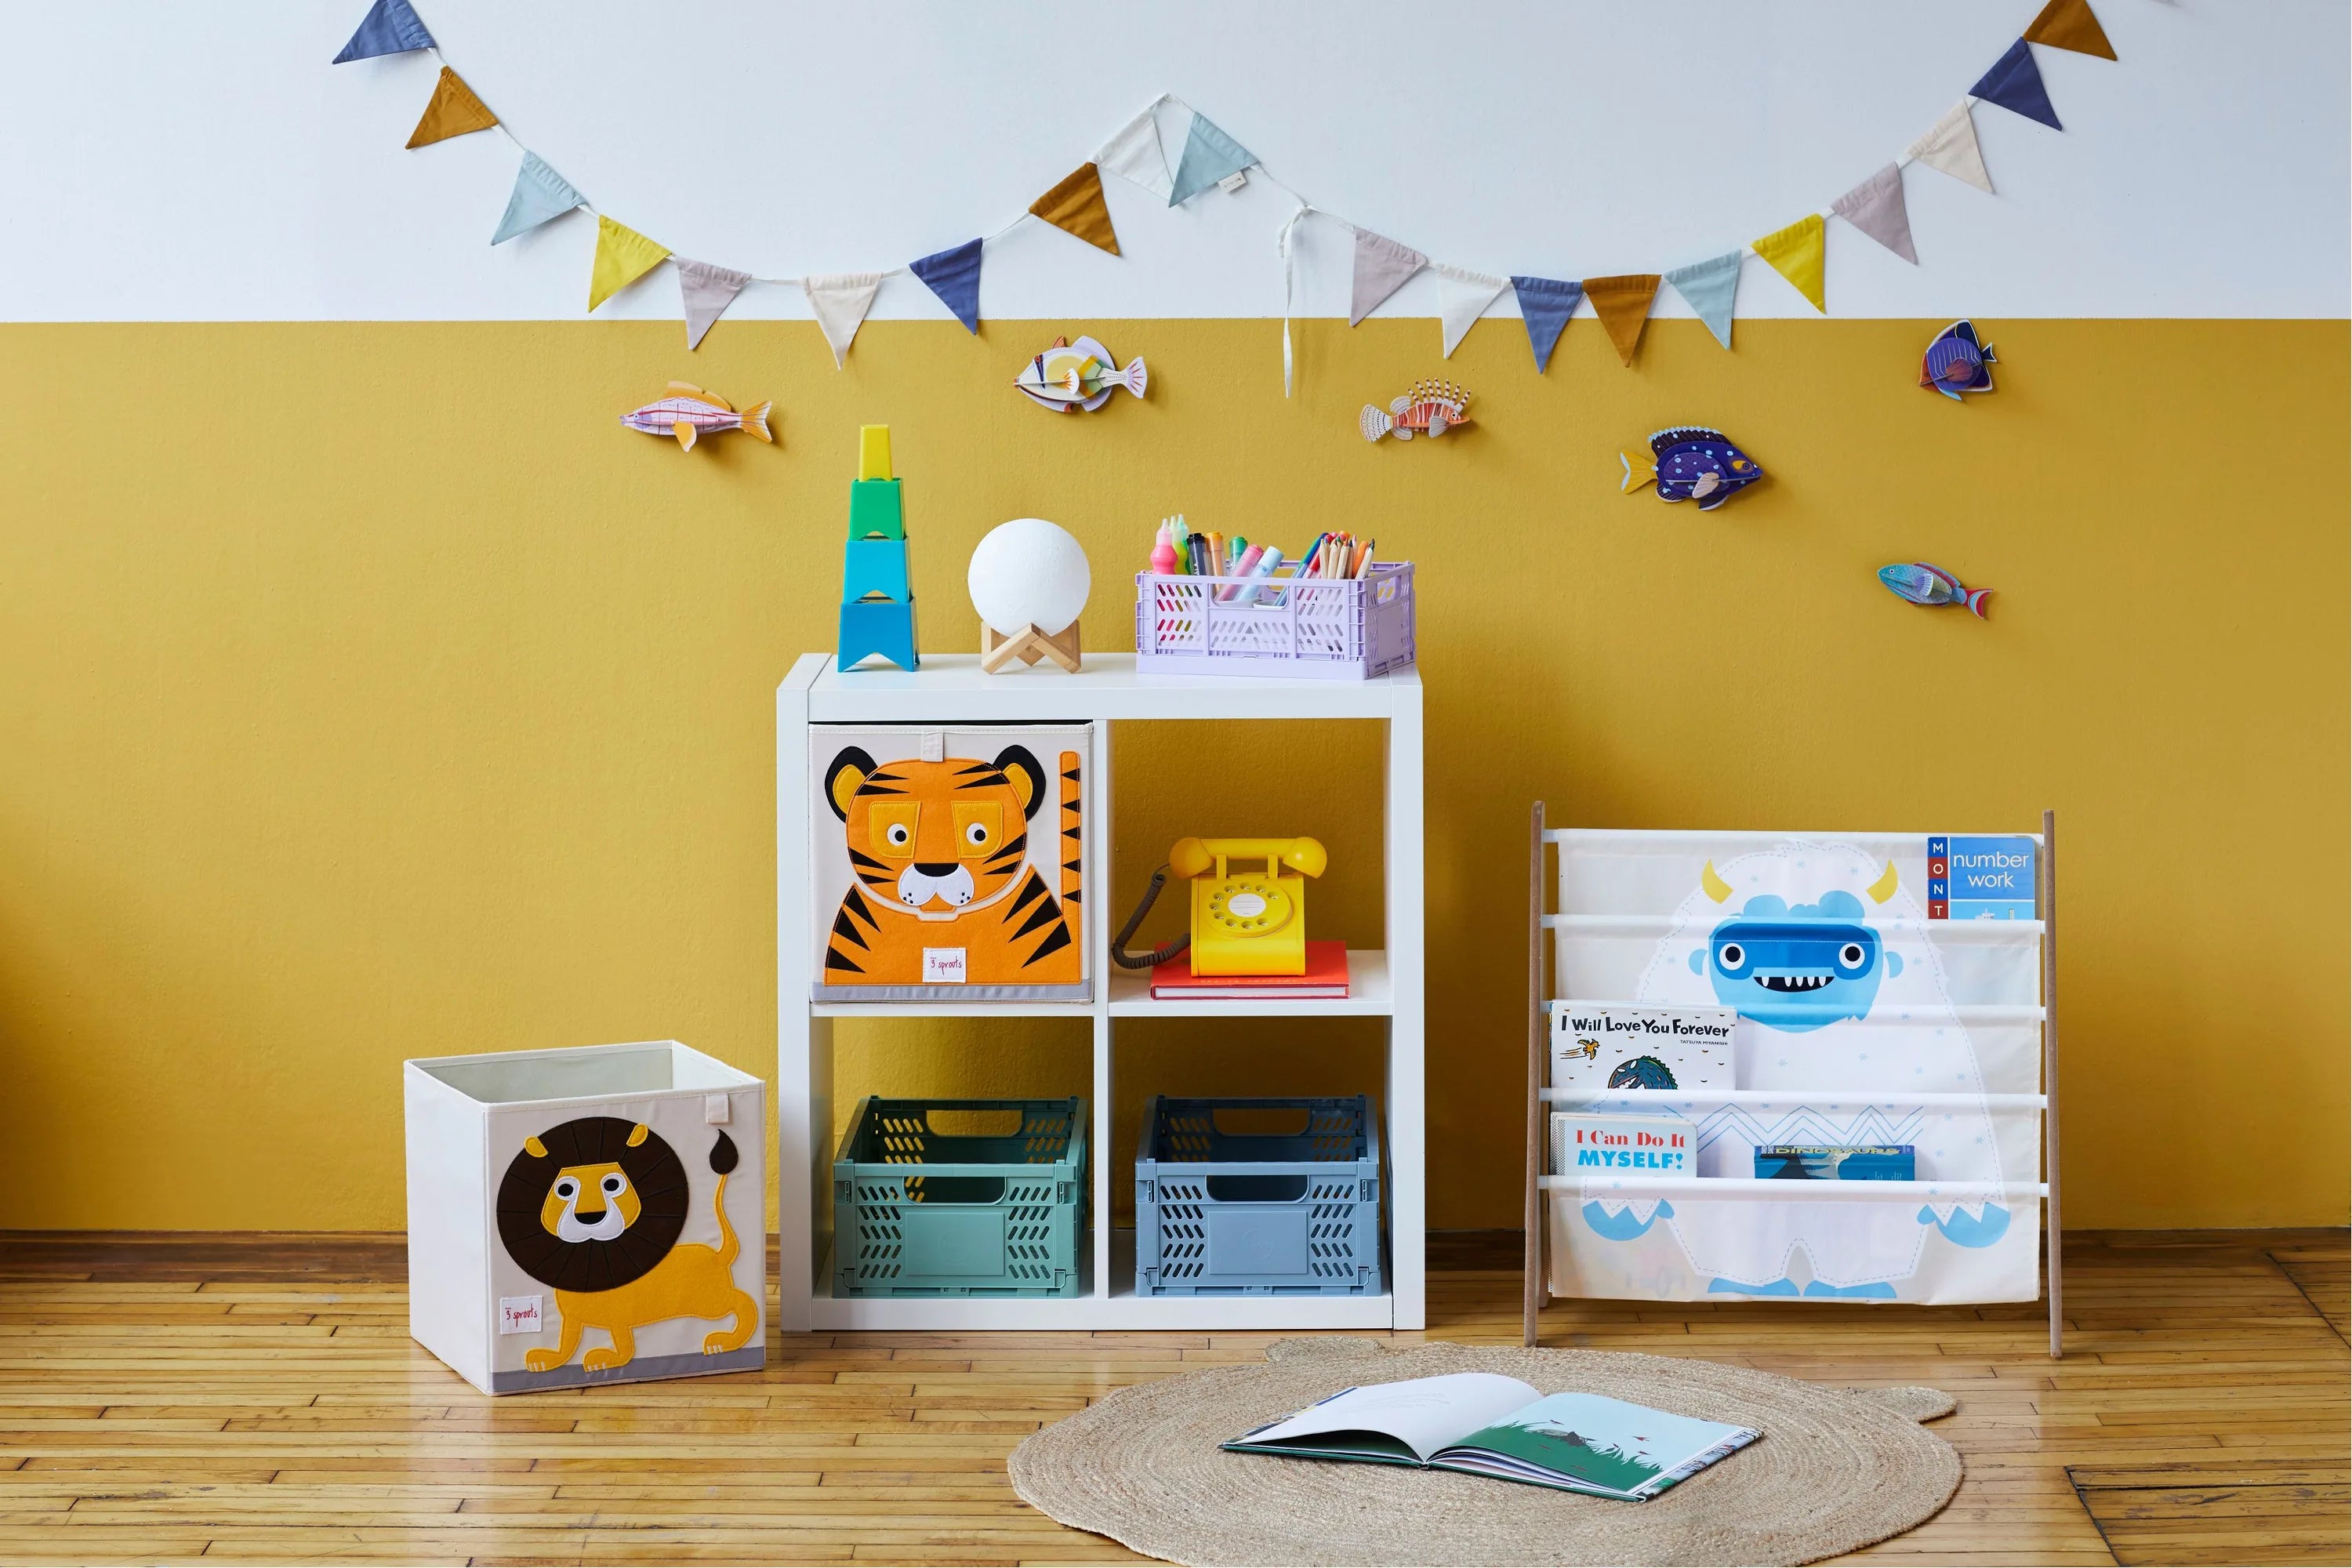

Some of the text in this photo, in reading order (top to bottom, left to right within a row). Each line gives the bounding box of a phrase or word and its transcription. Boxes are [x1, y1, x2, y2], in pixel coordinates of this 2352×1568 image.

[1953, 851, 2029, 868] number
[1967, 871, 2014, 887] work
[938, 955, 962, 976] sprouts
[1561, 1015, 1730, 1037] I Will Love You Forever
[1576, 1130, 1685, 1148] I Can Do It
[1577, 1149, 1684, 1170] MYSELF!
[513, 1302, 538, 1327] sprouts
